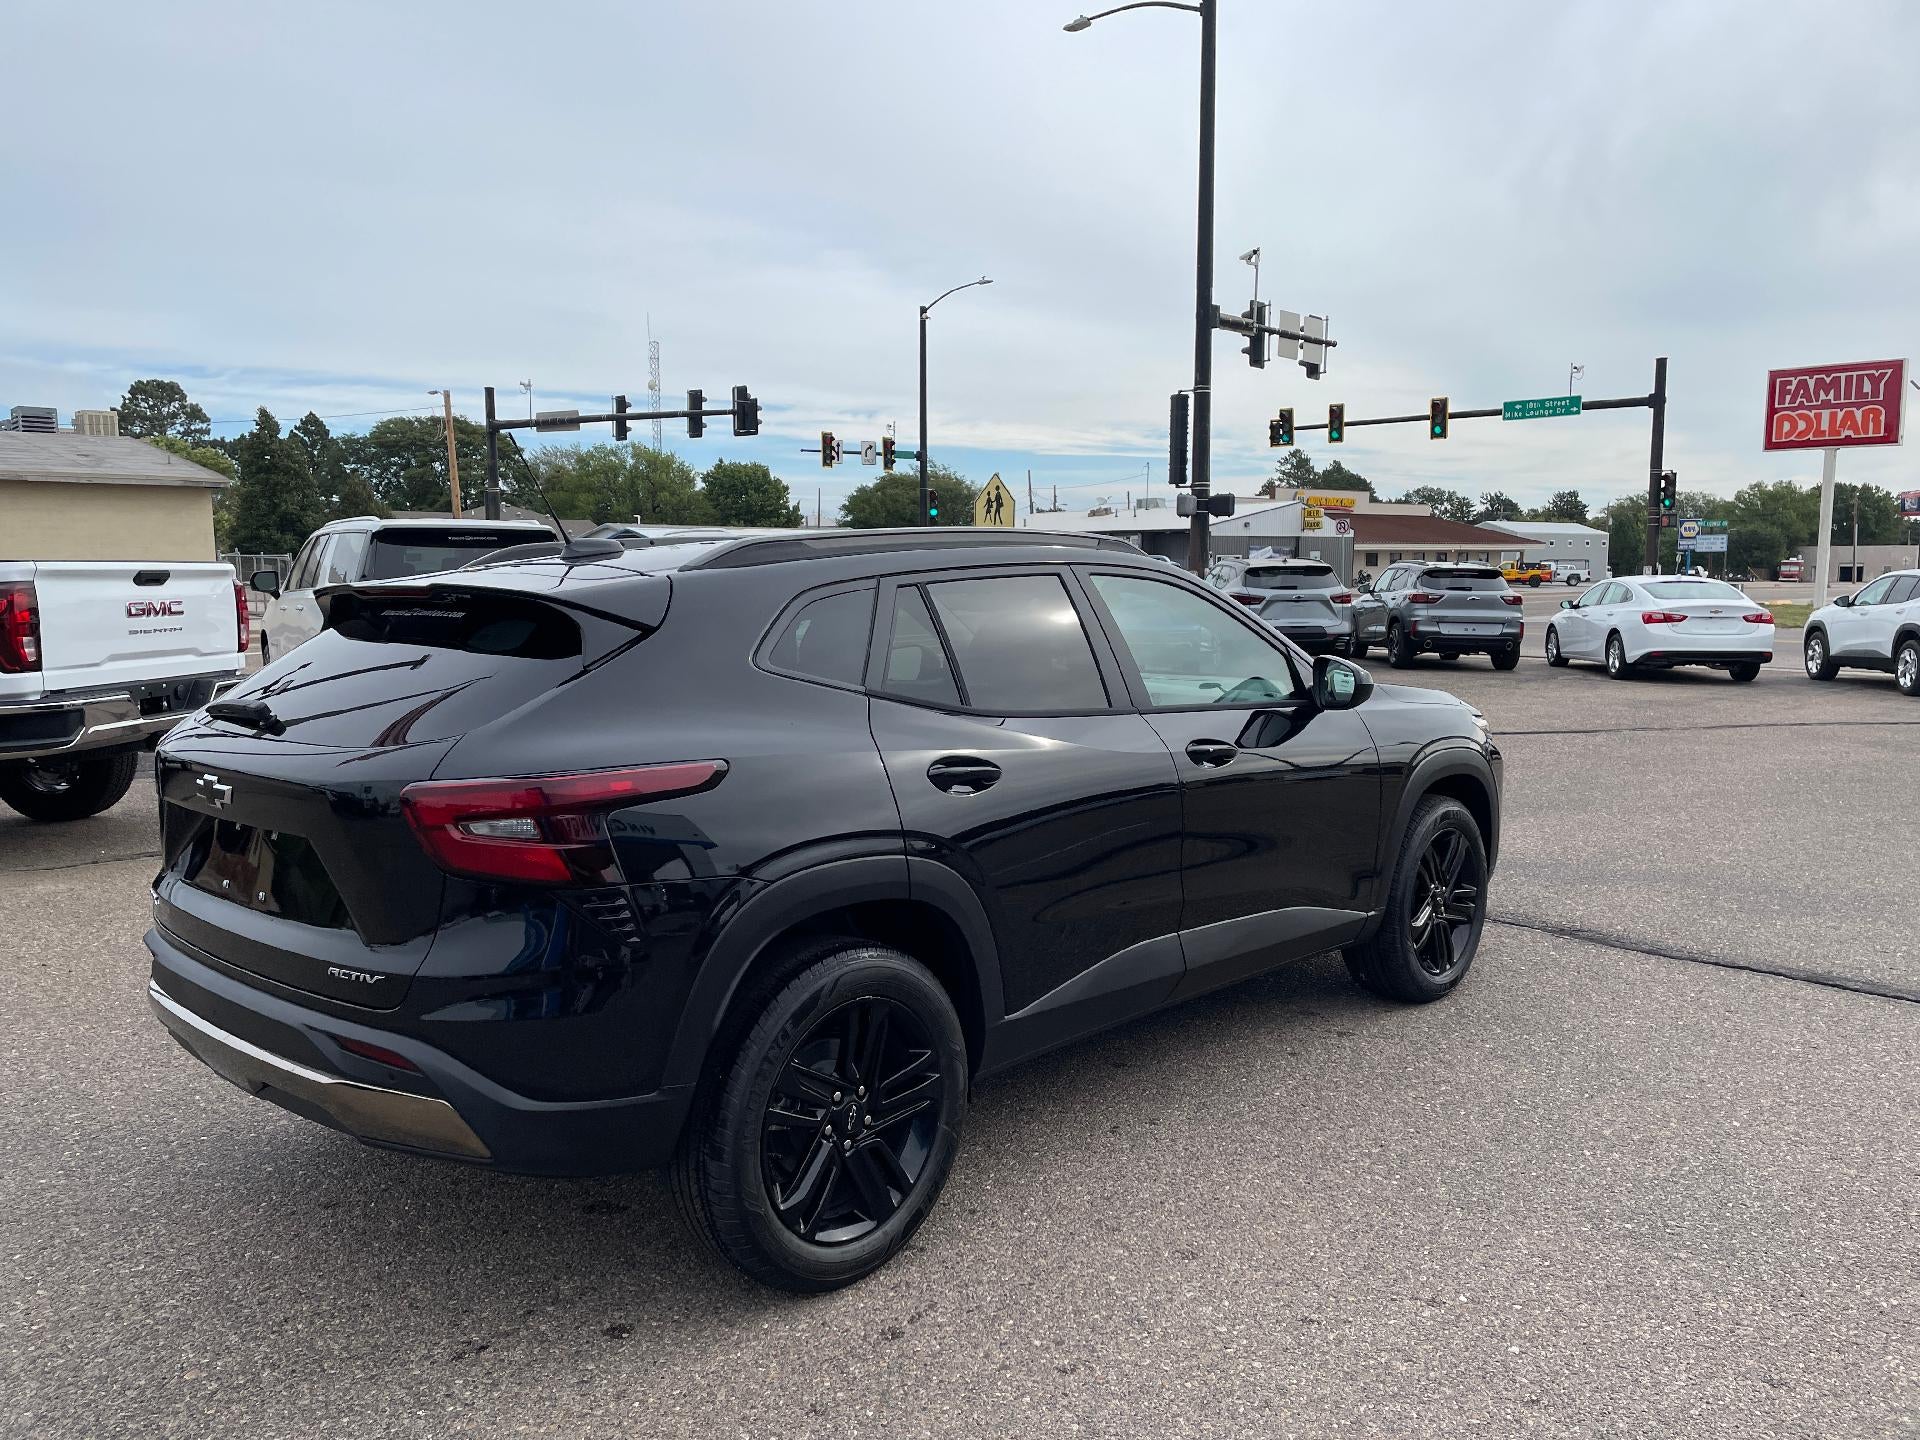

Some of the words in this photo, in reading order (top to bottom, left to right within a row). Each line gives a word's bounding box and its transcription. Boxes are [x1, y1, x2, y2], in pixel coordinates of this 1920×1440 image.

[1775, 369, 1893, 408] FAMILY
[1544, 399, 1570, 408] Street
[1504, 410, 1523, 419] Mike
[1525, 408, 1553, 417] Lounge
[1772, 405, 1887, 442] DOLLAR
[1306, 509, 1320, 517] BEER
[127, 600, 185, 618] GMC
[128, 626, 183, 636] SIERRA
[327, 966, 386, 984] ACTIV
